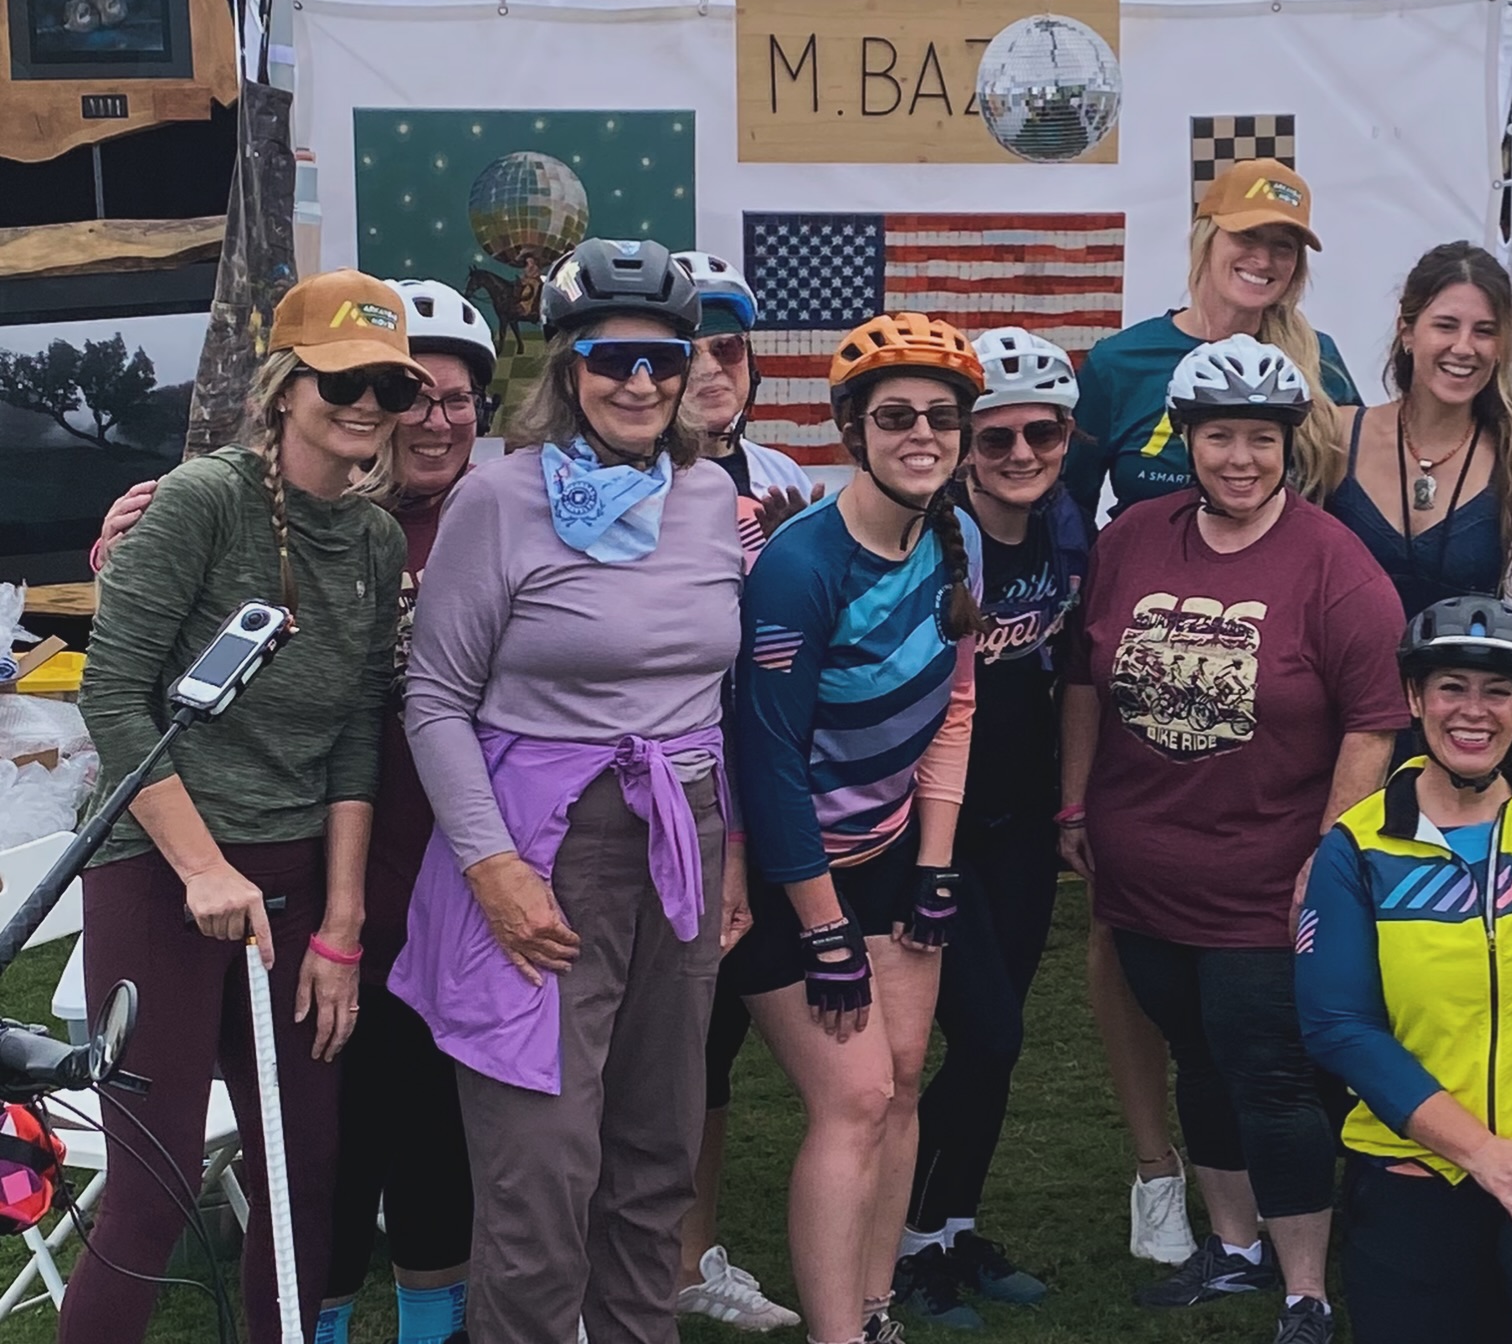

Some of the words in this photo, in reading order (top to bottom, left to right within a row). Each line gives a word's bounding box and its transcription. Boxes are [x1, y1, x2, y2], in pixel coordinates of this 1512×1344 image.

[1137, 470, 1145, 479] A
[1149, 471, 1192, 484] SMART
[1181, 732, 1217, 751] RIDE
